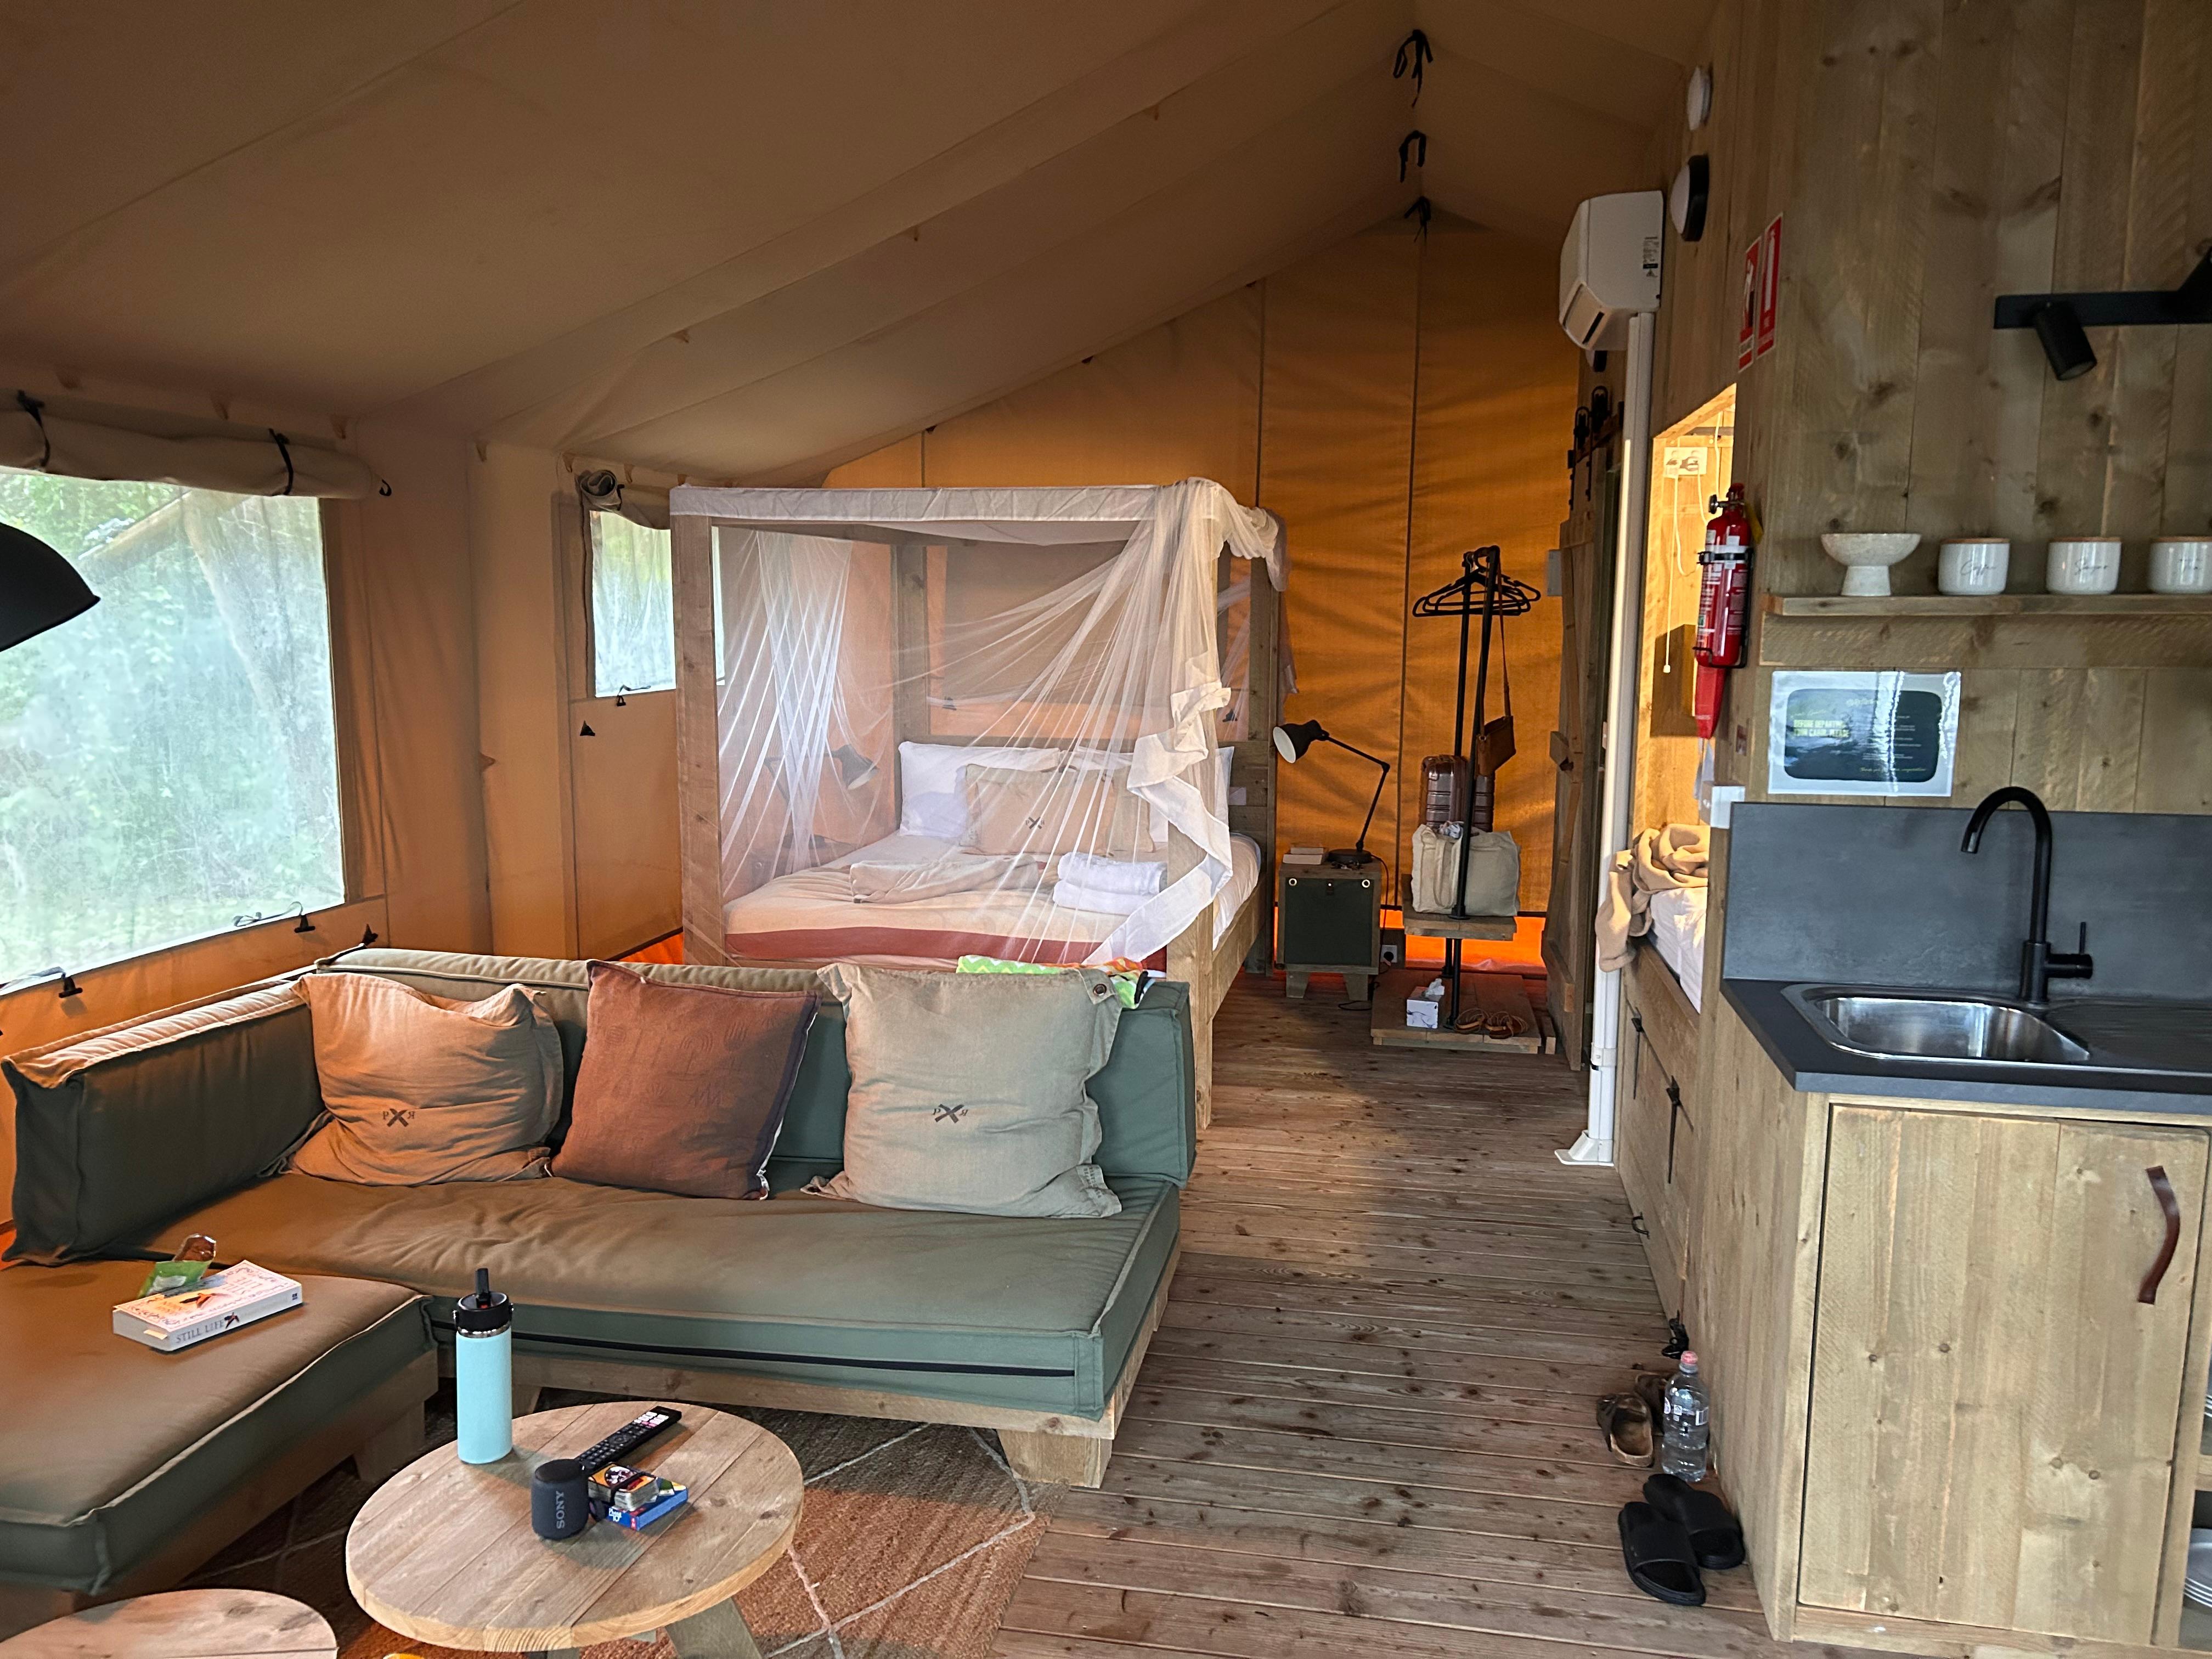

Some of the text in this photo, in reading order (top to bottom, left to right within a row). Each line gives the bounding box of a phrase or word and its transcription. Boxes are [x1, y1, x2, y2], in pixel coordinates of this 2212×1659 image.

[175, 1319, 224, 1344] STILL LIFE
[556, 1491, 565, 1529] SONY
